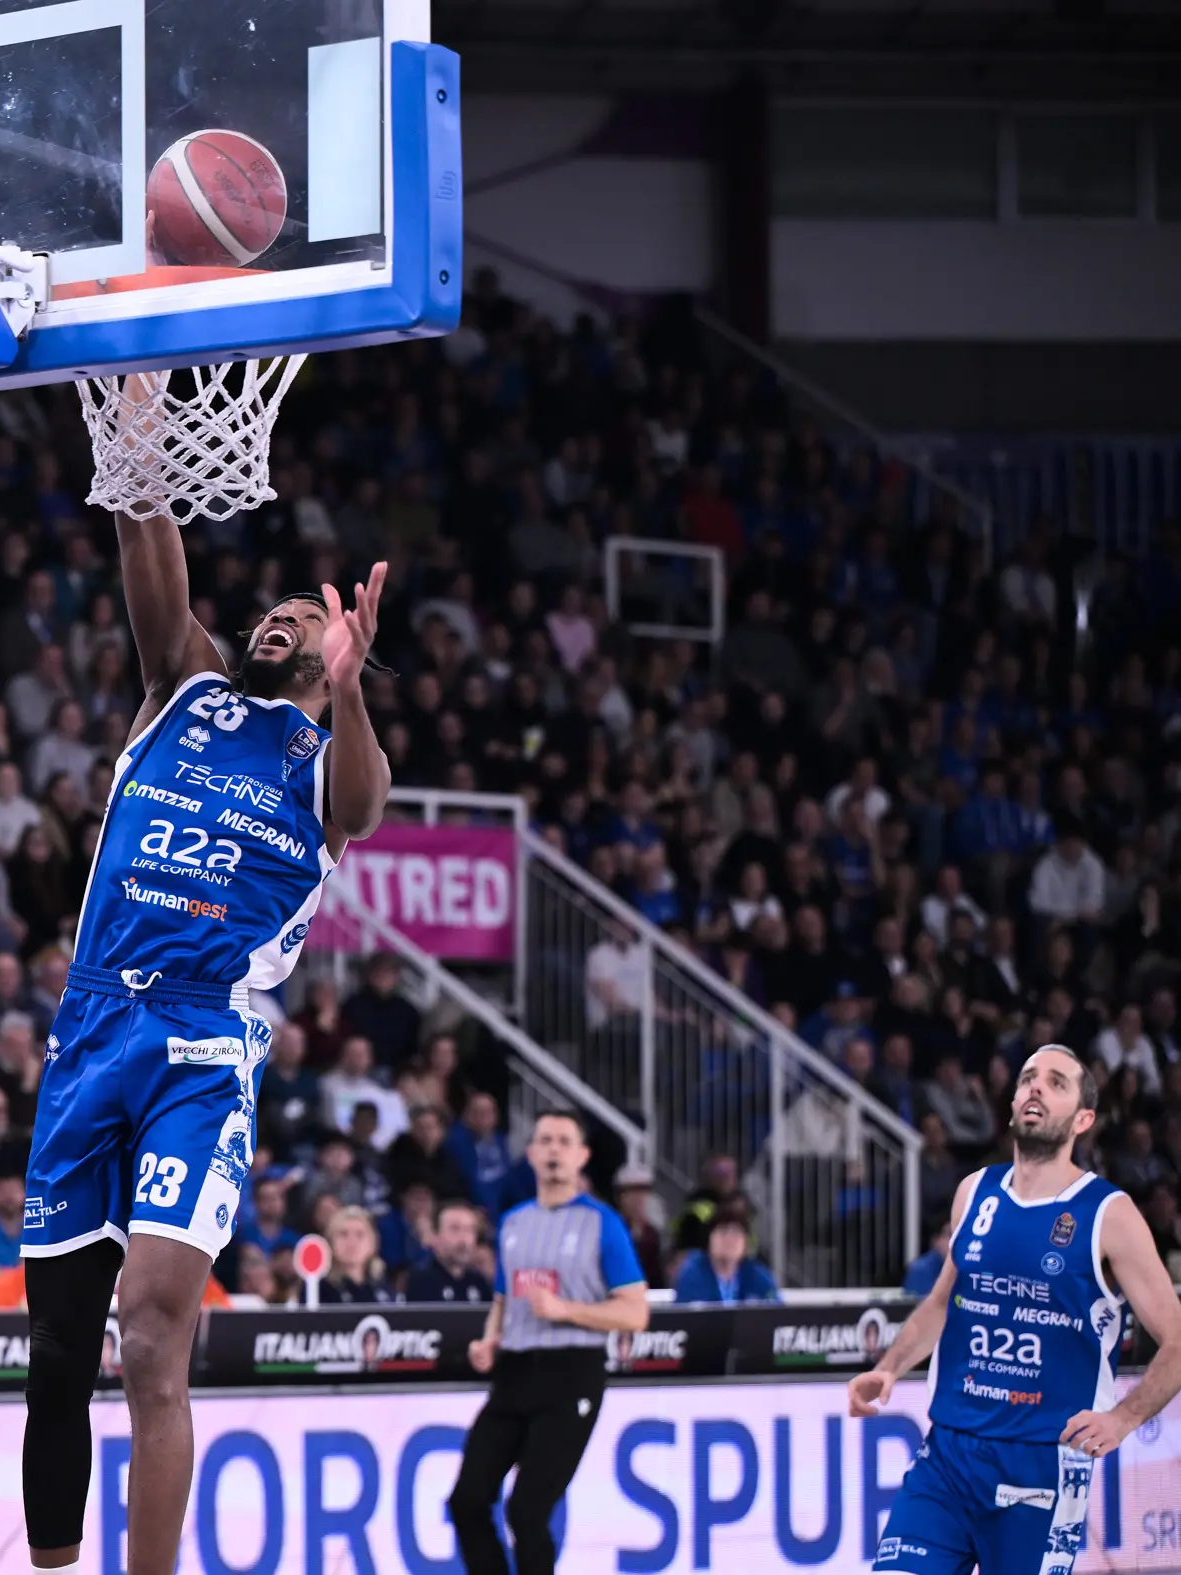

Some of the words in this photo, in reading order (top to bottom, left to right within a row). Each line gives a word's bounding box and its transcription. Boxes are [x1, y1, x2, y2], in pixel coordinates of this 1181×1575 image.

[187, 687, 249, 731] 23
[140, 819, 242, 873] a2a
[216, 808, 306, 860] MEGRANI
[131, 857, 159, 871] LIFE
[160, 864, 232, 887] COMPANY
[121, 876, 228, 922] Humangest
[134, 1152, 188, 1208] 23
[24, 1200, 68, 1218] ALTELO
[972, 1196, 999, 1236] 8
[253, 1332, 355, 1363] ITALIAN
[352, 1314, 442, 1363] OPTIC
[772, 1324, 858, 1354] ITALIAN
[1012, 1307, 1083, 1332] MEGRANI
[969, 1324, 1043, 1367] a2a
[963, 1375, 1043, 1405] Humangest
[968, 1359, 987, 1372] LIFE
[988, 1361, 1041, 1379] COMPANY
[1141, 1508, 1181, 1552] SR
